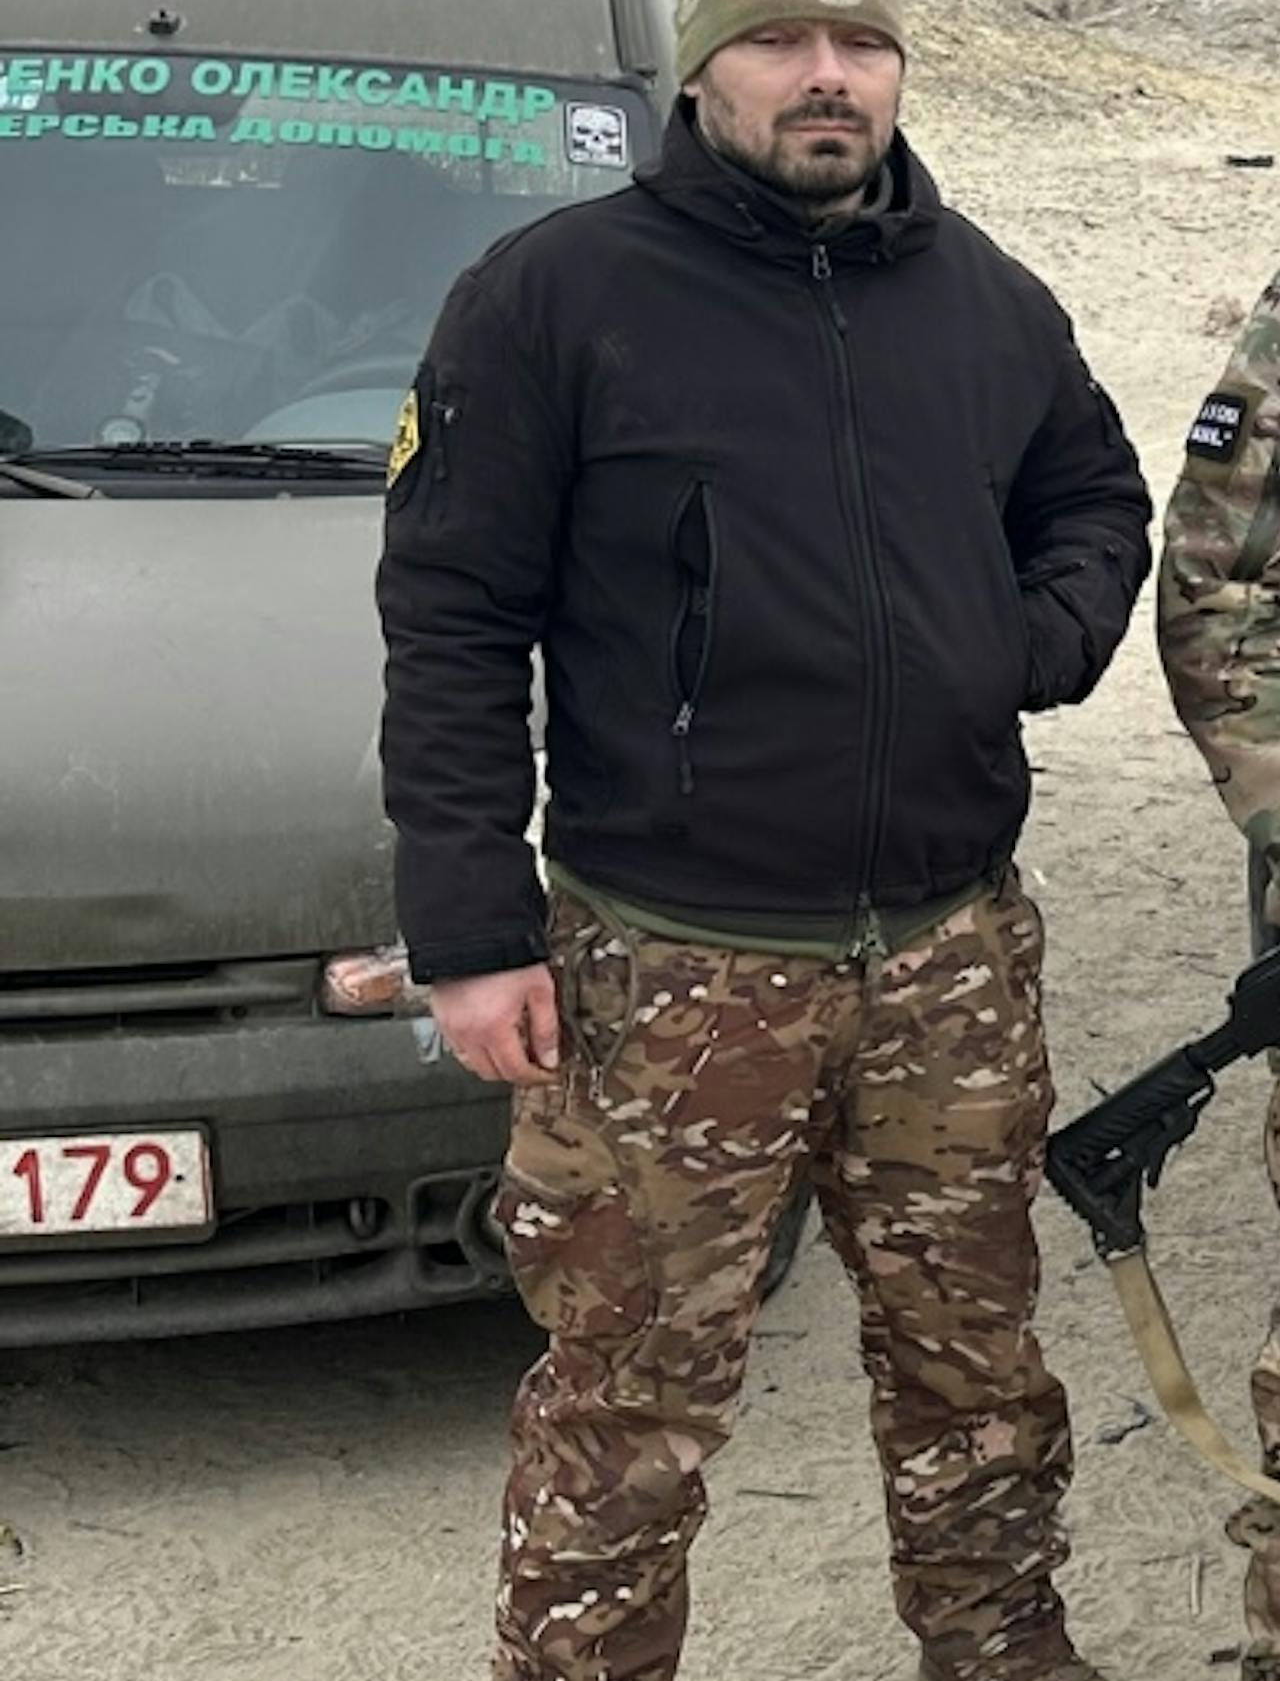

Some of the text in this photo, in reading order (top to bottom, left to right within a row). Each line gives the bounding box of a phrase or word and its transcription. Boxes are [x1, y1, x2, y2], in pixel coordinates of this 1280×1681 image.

[0, 58, 556, 124] ЕНКО ОЛЕКСАНДР
[12, 1142, 171, 1224] 179
